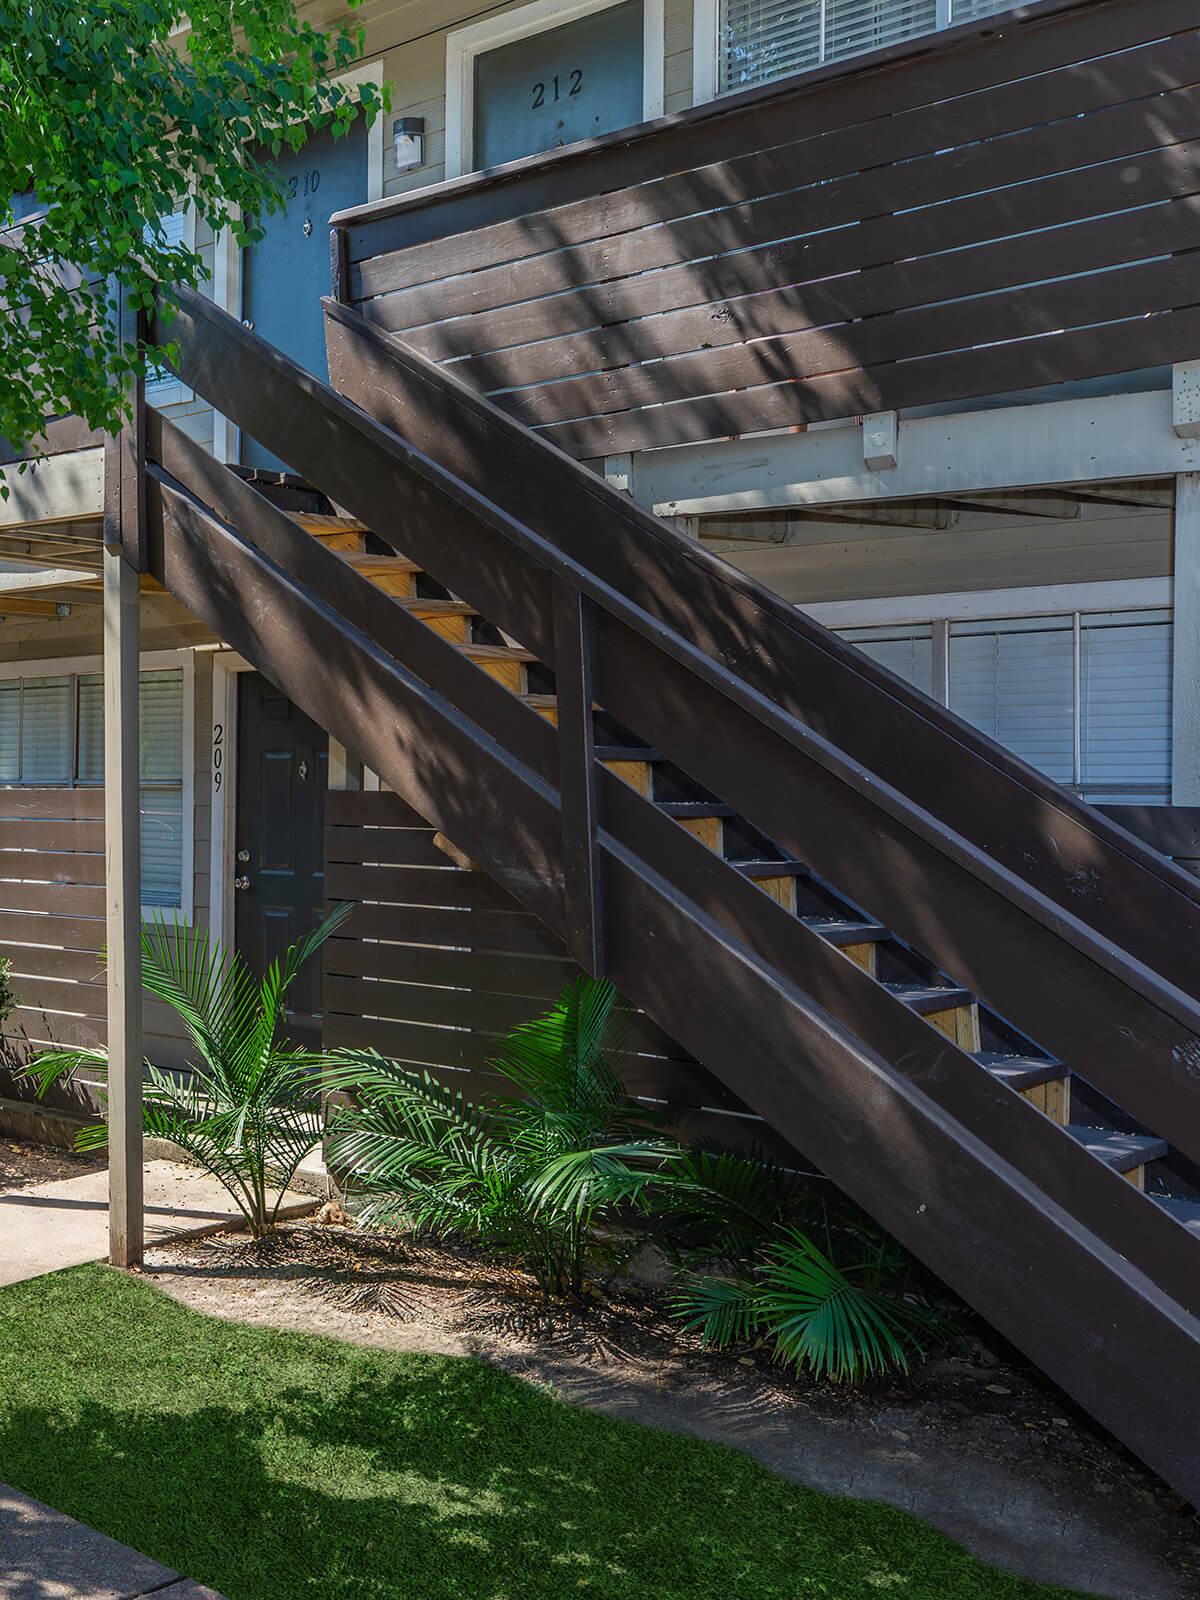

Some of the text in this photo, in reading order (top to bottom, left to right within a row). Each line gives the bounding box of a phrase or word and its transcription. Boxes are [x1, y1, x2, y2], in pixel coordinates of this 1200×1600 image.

[531, 69, 583, 110] 212
[287, 169, 320, 200] 210
[213, 724, 223, 793] 209
